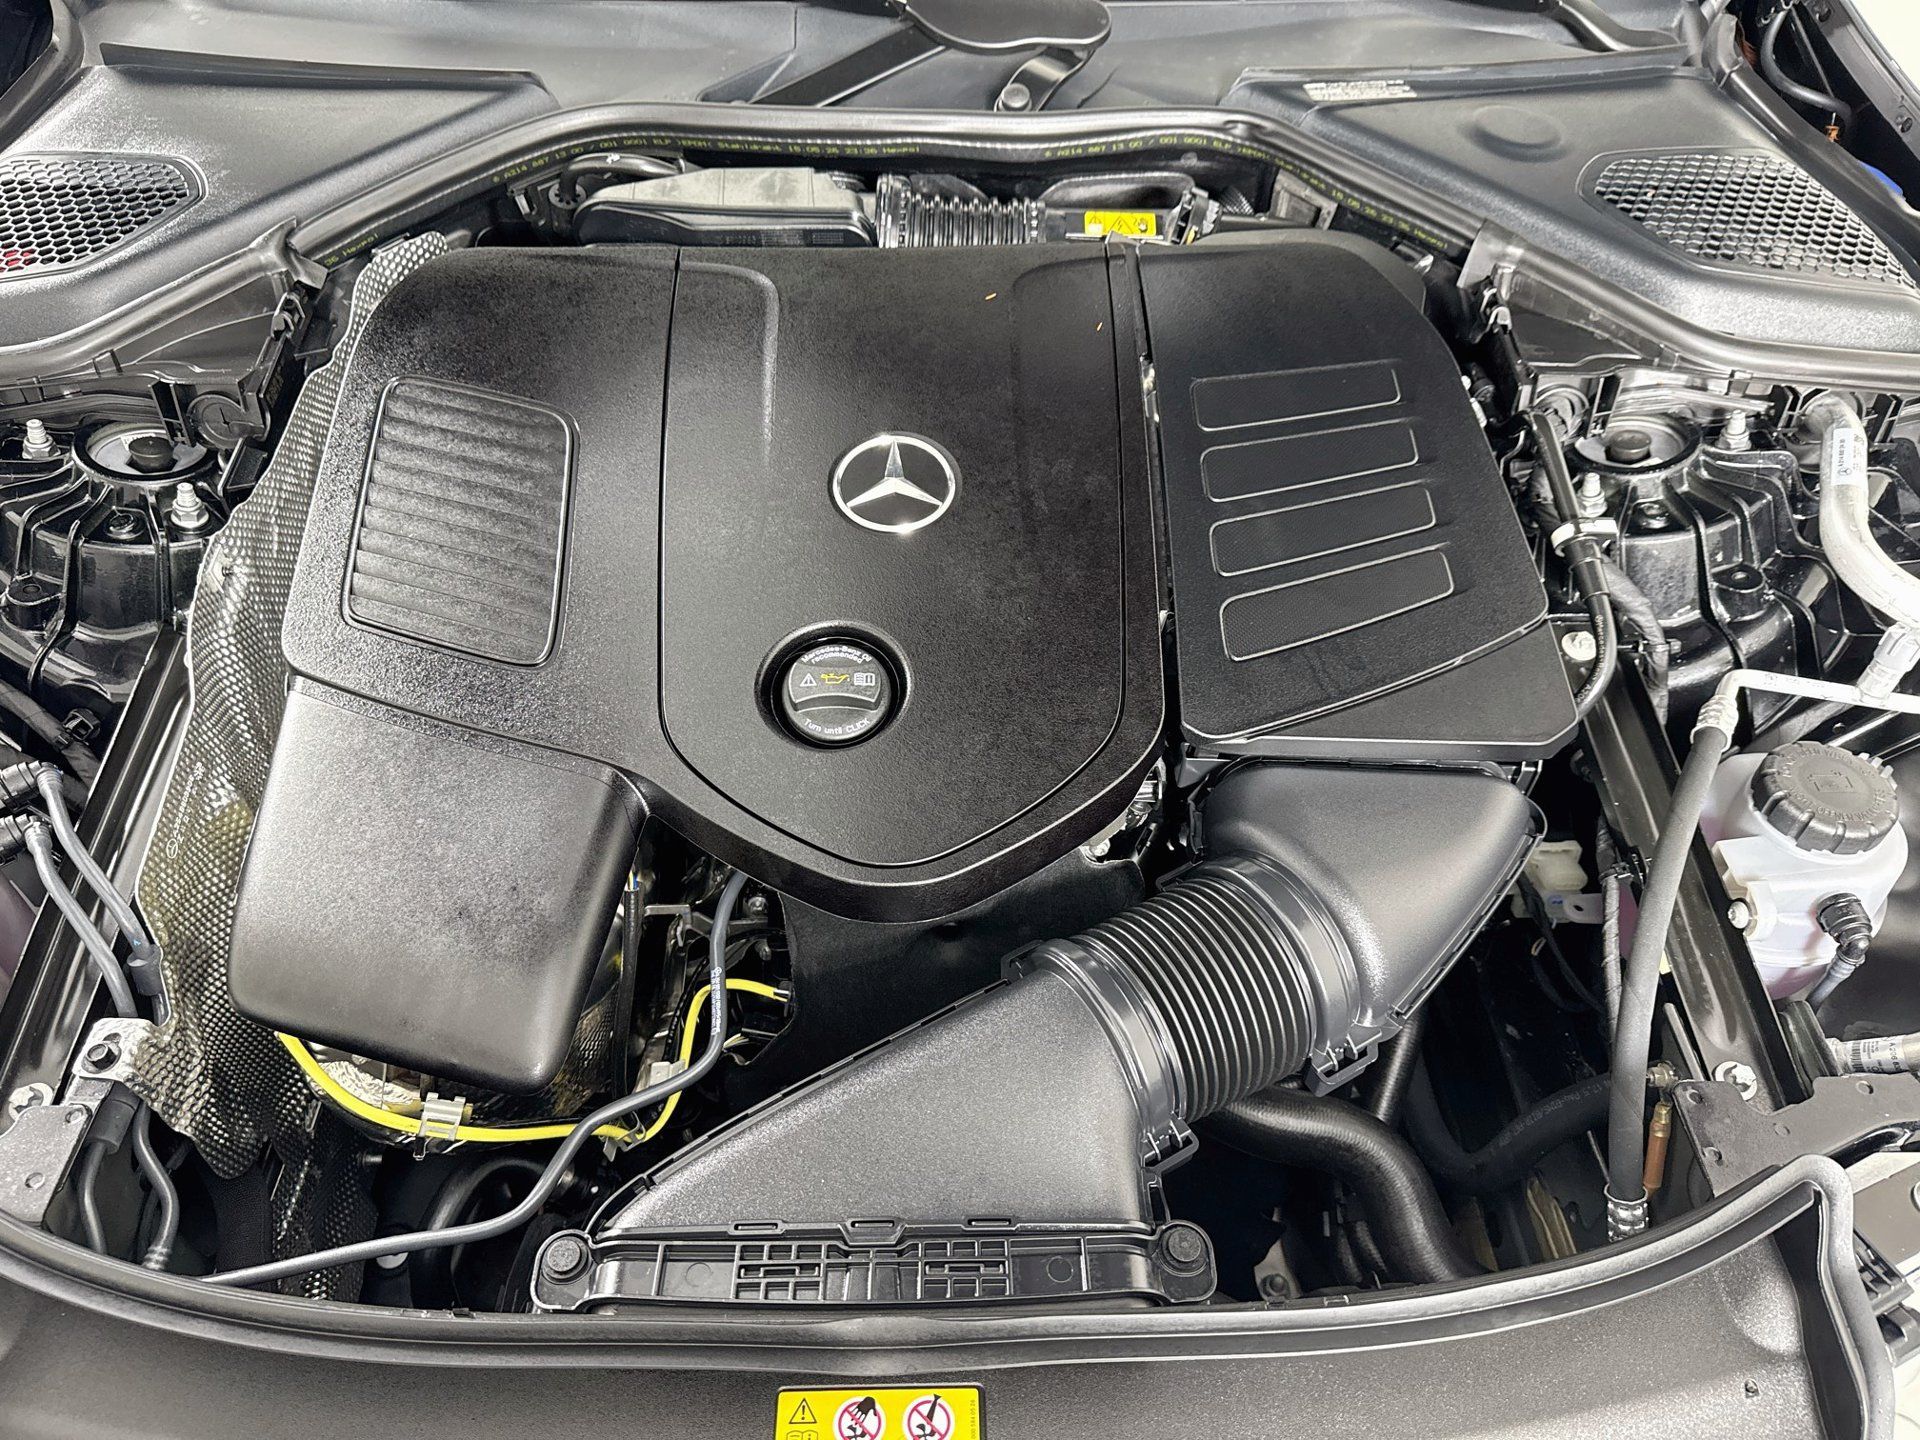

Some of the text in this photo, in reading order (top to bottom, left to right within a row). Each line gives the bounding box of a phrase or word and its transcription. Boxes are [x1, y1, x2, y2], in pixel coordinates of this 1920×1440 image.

[801, 645, 862, 663] Mercedes-Benz
[811, 651, 864, 664] recommended
[804, 717, 871, 735] Turn until CLICK
